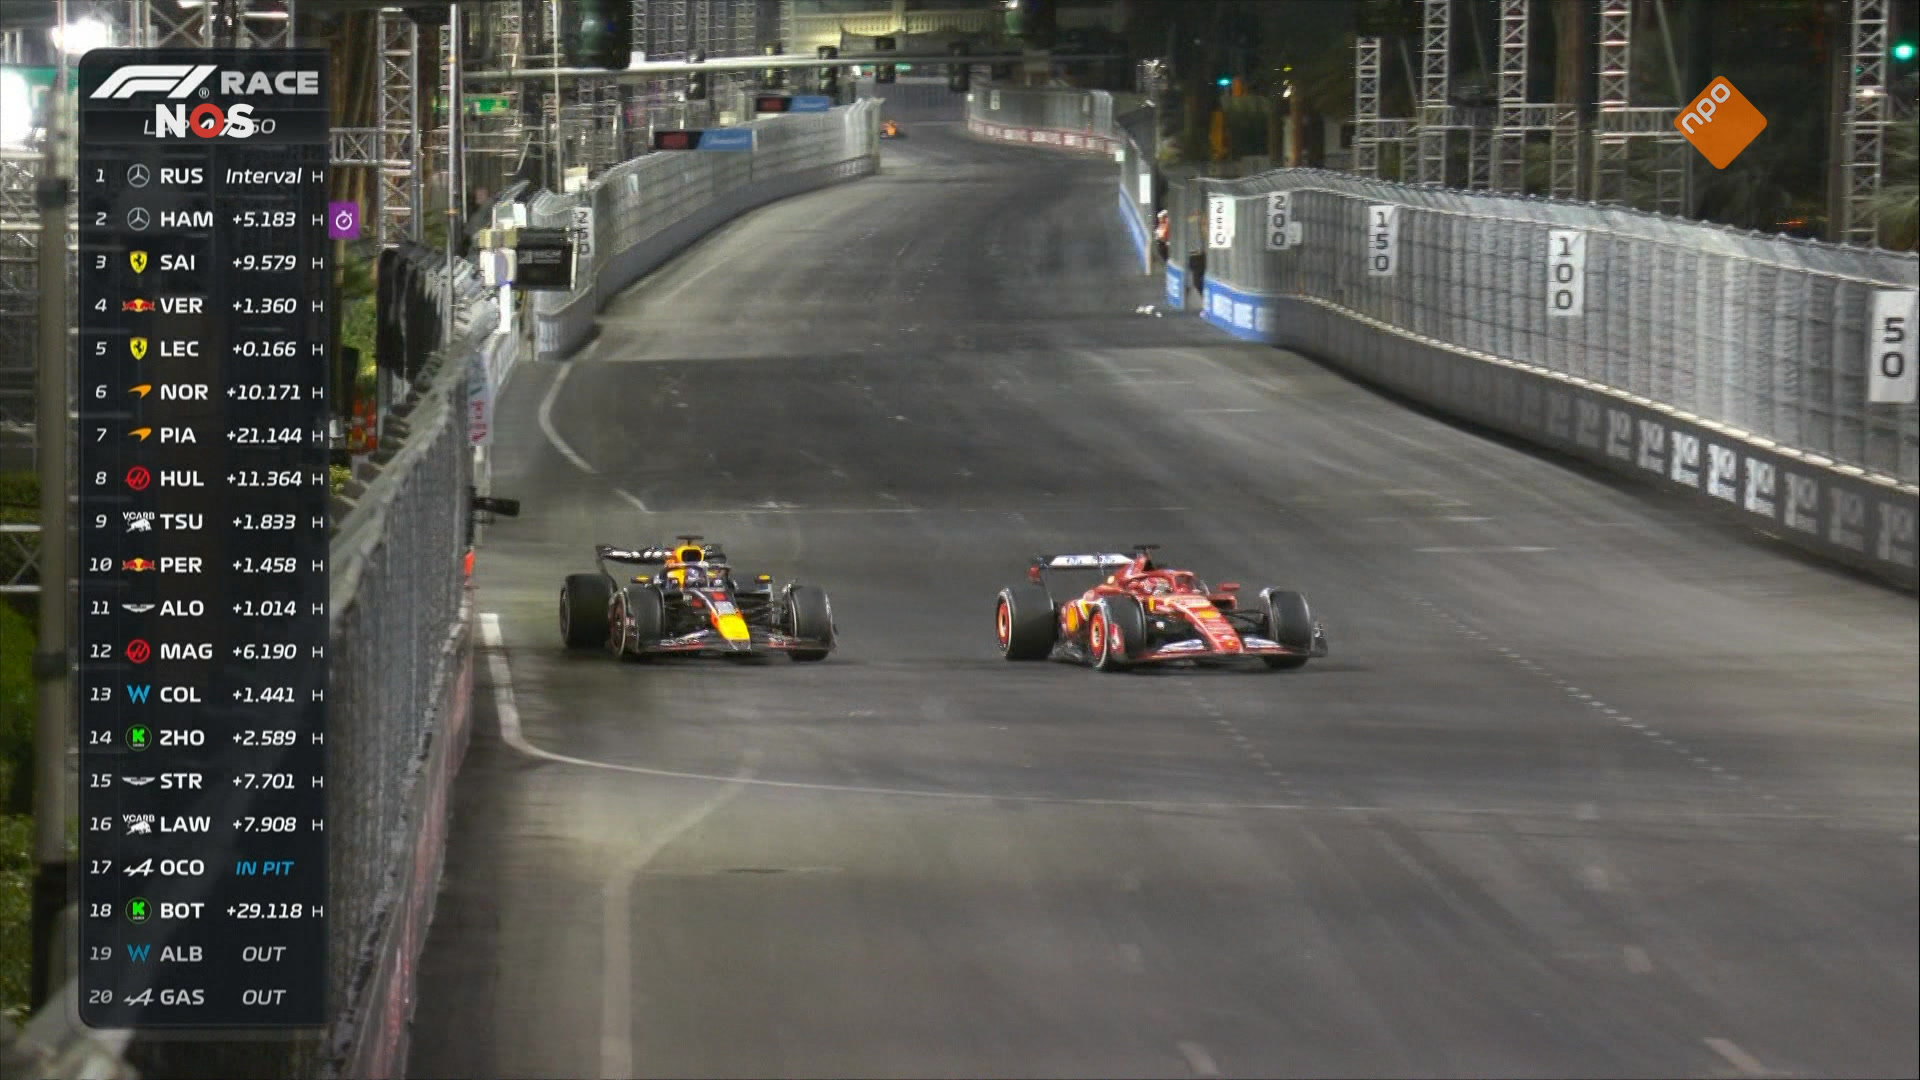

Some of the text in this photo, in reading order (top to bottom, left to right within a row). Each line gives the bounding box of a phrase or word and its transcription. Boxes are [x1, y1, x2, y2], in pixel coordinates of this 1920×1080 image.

[1271, 195, 1286, 246] 200
[1375, 211, 1390, 272] 150
[1555, 236, 1574, 310] 100
[1881, 316, 1905, 378] 50
